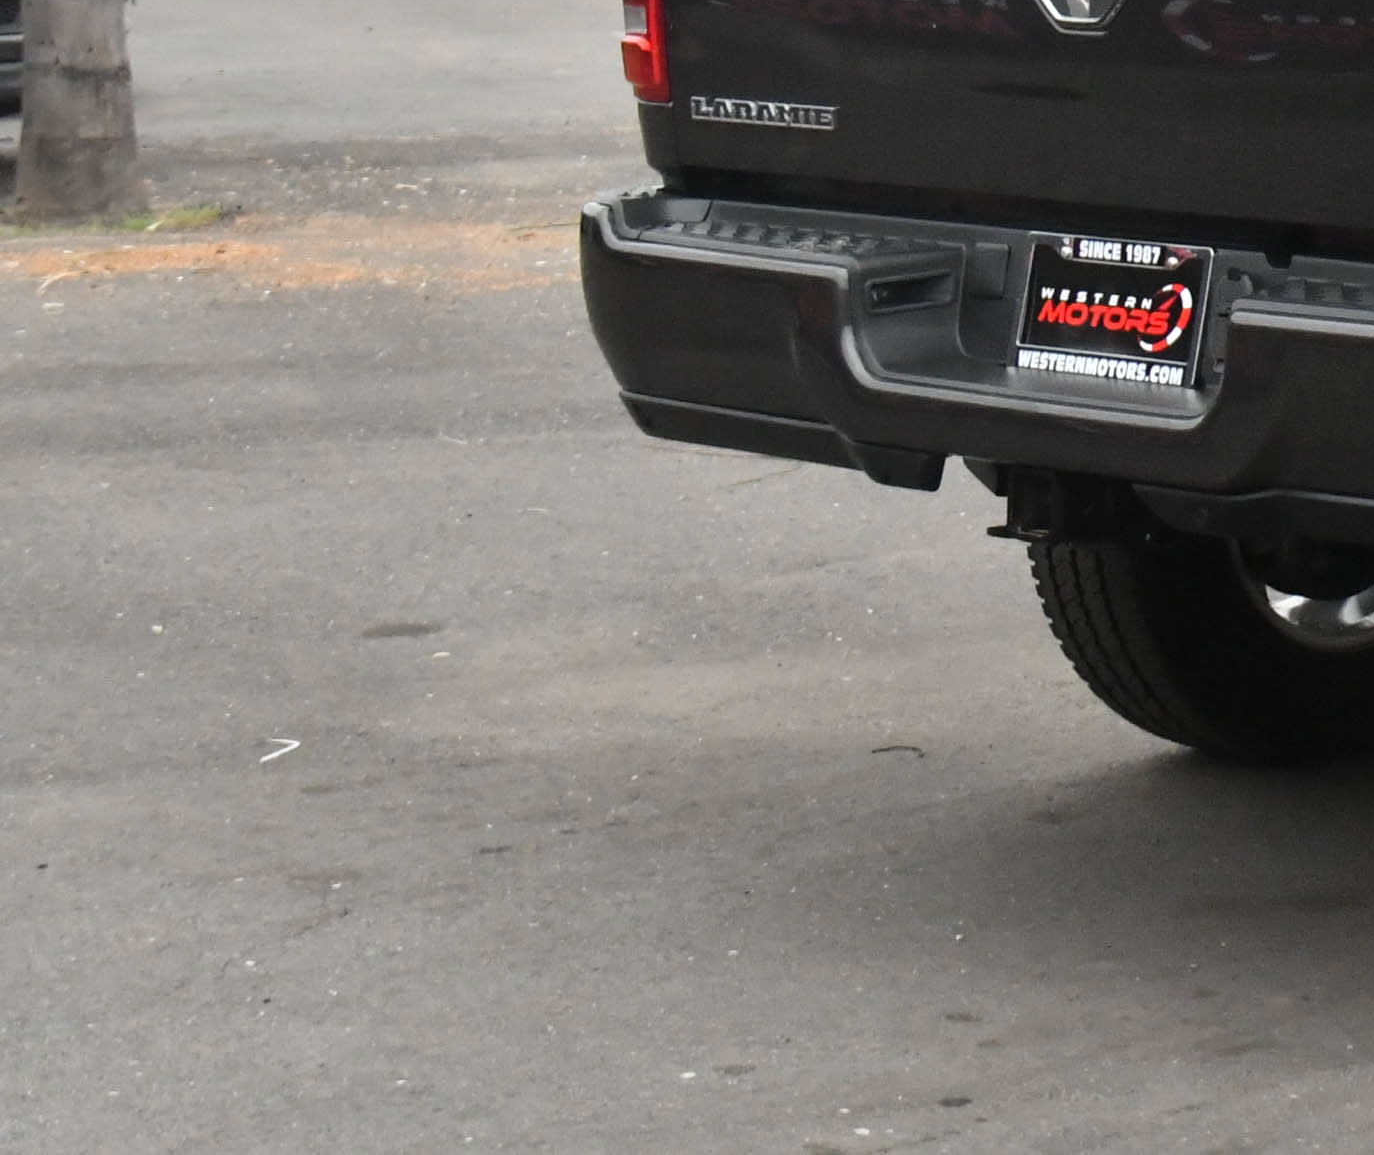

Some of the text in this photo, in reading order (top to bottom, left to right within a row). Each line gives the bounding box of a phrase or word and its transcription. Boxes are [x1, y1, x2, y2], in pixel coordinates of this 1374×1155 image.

[691, 95, 838, 131] LARAMIE
[1078, 239, 1162, 265] SINCE 1987
[1040, 286, 1153, 310] WESTERN
[1037, 299, 1171, 336] MOTORS
[1017, 348, 1184, 386] WESTERNMOTORS.COM
